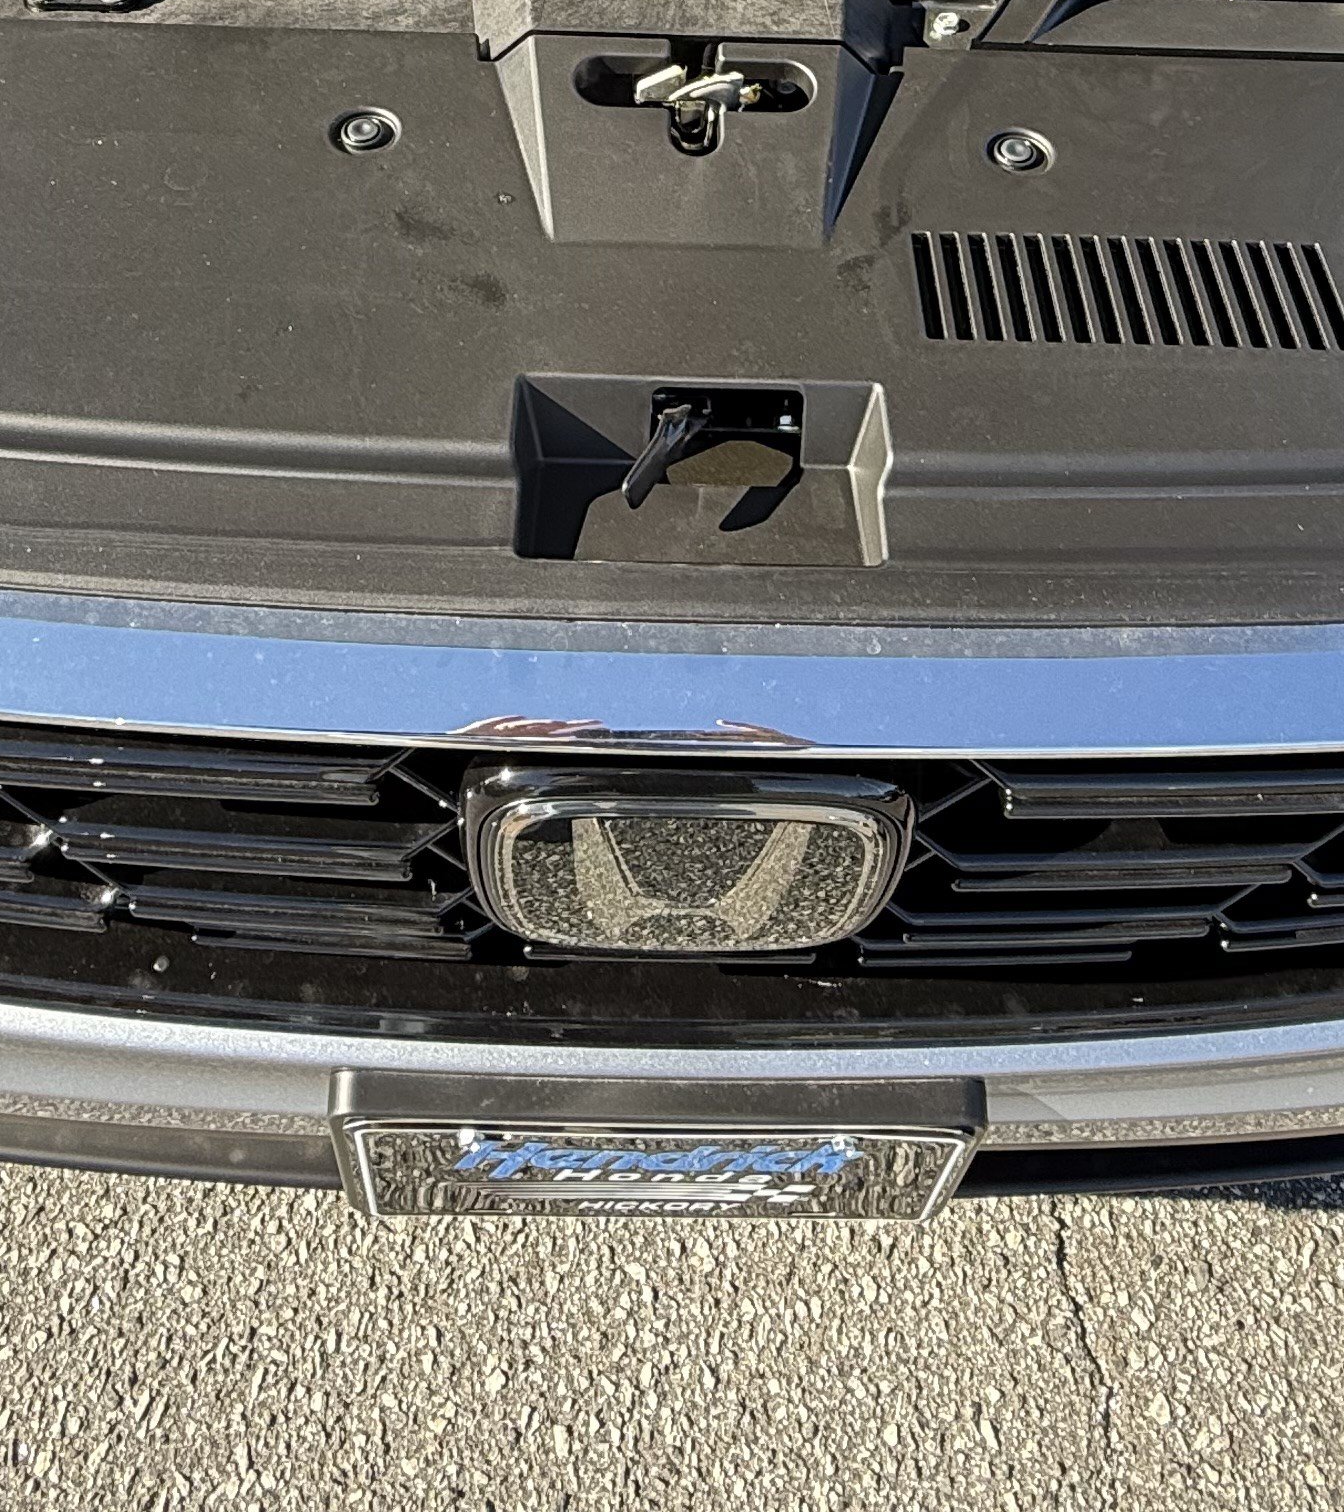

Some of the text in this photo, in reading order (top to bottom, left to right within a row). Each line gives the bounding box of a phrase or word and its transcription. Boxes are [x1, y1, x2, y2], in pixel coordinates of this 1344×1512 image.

[453, 1141, 865, 1179] Hendrick
[553, 1168, 774, 1182] Honda
[577, 1199, 742, 1211] HICKORY
